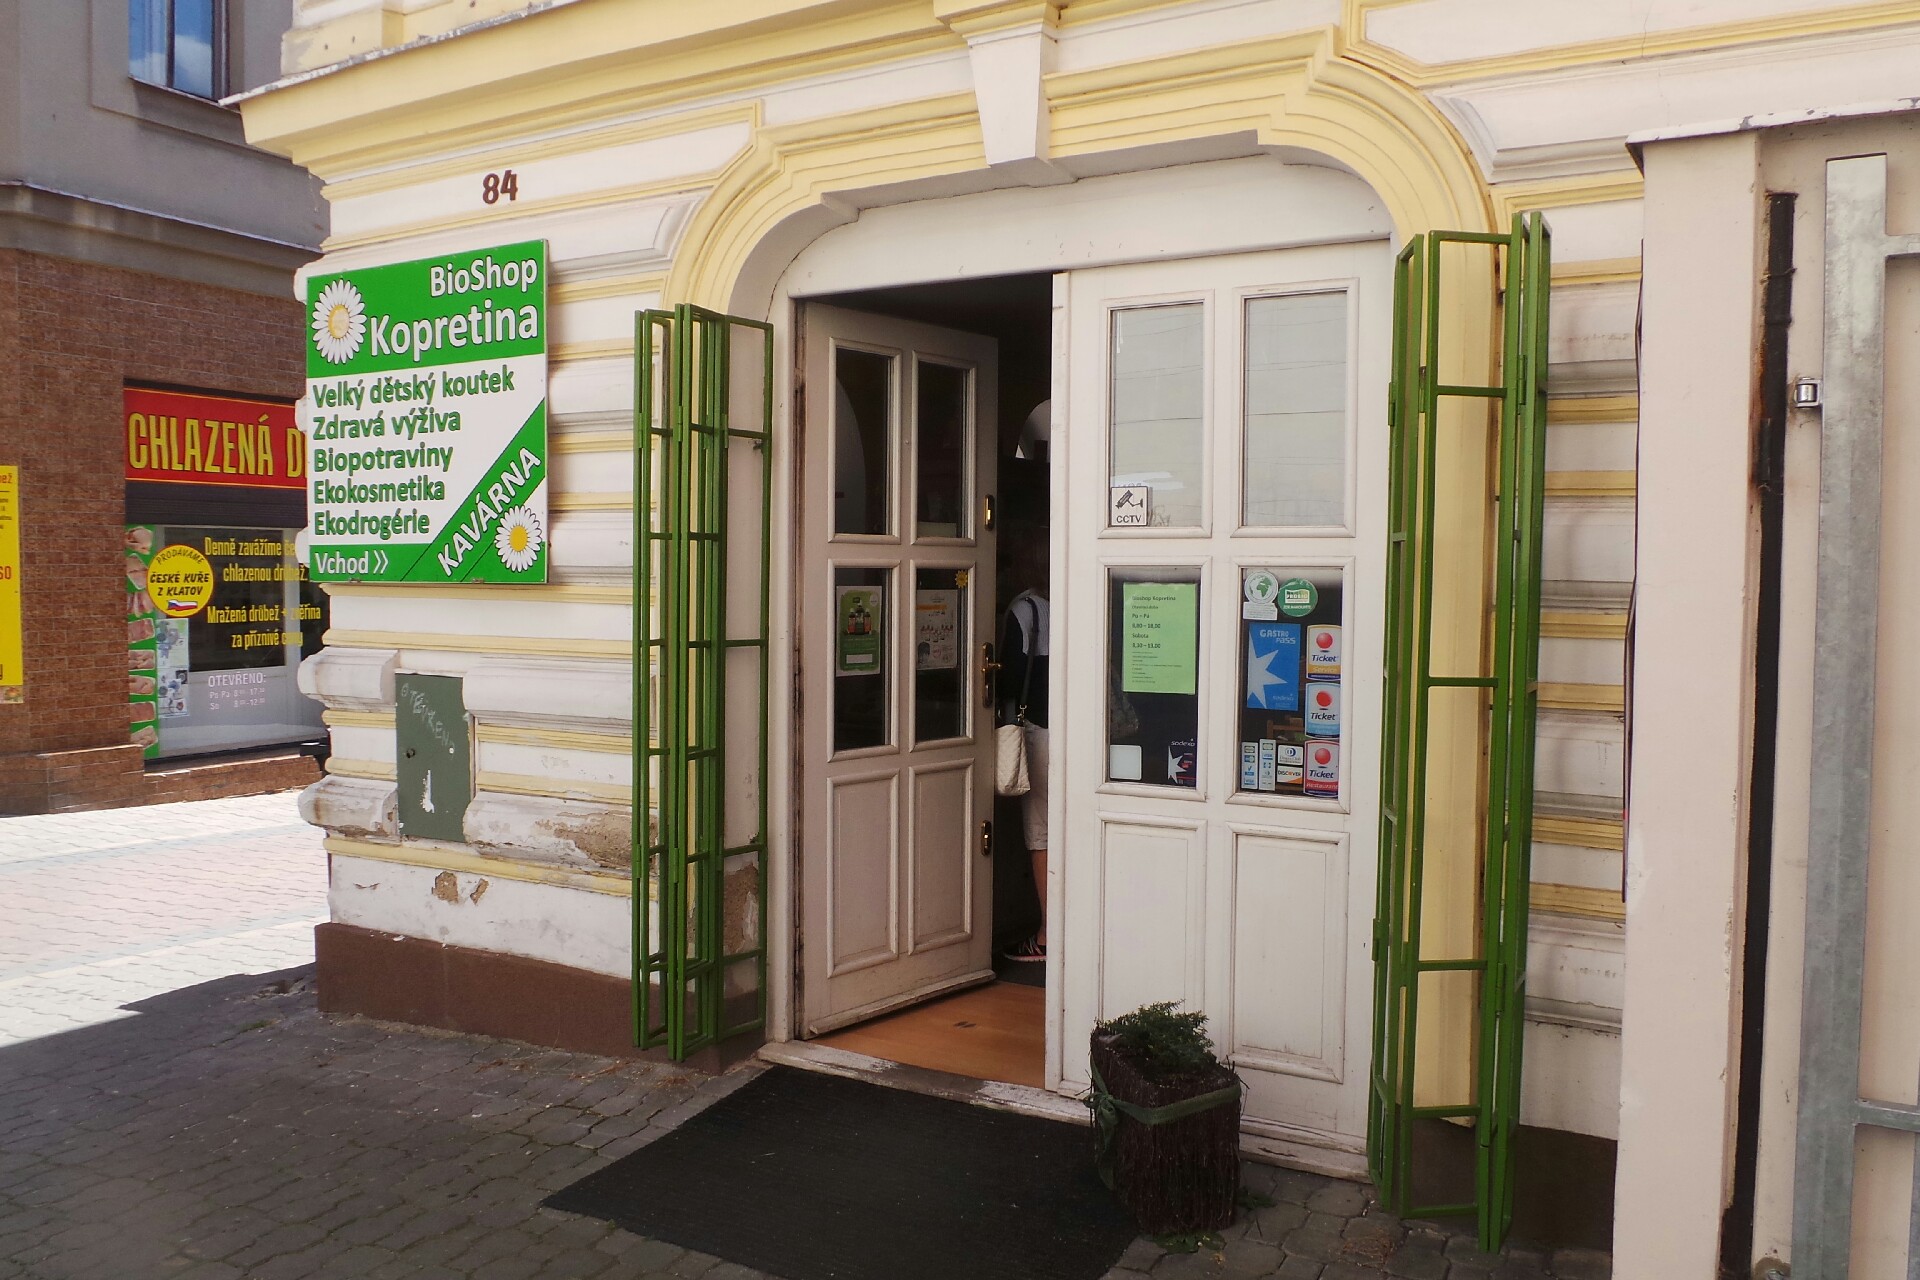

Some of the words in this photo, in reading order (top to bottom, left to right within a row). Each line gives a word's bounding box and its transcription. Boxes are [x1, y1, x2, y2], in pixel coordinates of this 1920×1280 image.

[482, 169, 518, 205] 84
[430, 254, 538, 298] BioShop
[370, 298, 539, 362] Kopretina
[313, 378, 365, 408] Velký
[370, 372, 436, 404] dětský
[442, 364, 515, 398] koutek
[313, 409, 386, 441] Zdravá
[391, 406, 461, 440] výživa
[128, 412, 274, 476] CHLAZENÁ
[313, 443, 454, 477] Biopotraviny
[313, 478, 445, 505] Ekokosmetika
[436, 446, 541, 577] KAVÁRNA
[1116, 515, 1142, 524] CCTV
[313, 509, 430, 542] Ekodrogérie
[205, 536, 236, 556] Denně
[238, 538, 282, 556] zavážíme
[223, 562, 272, 582] chlazenou
[315, 550, 370, 576] Vchod
[150, 571, 180, 584] ČESKÉ
[184, 572, 210, 584] KUŘE
[158, 586, 163, 596] Z
[166, 586, 204, 596] KLATOV
[207, 605, 246, 624] Mražená
[250, 604, 280, 622] drůbež
[232, 634, 242, 648] za
[244, 629, 278, 650] příznivé
[1312, 654, 1336, 662] Ticket
[208, 671, 266, 688] OTEVŘENO:
[1310, 712, 1336, 720] Ticket
[1309, 770, 1334, 778] Ticket
